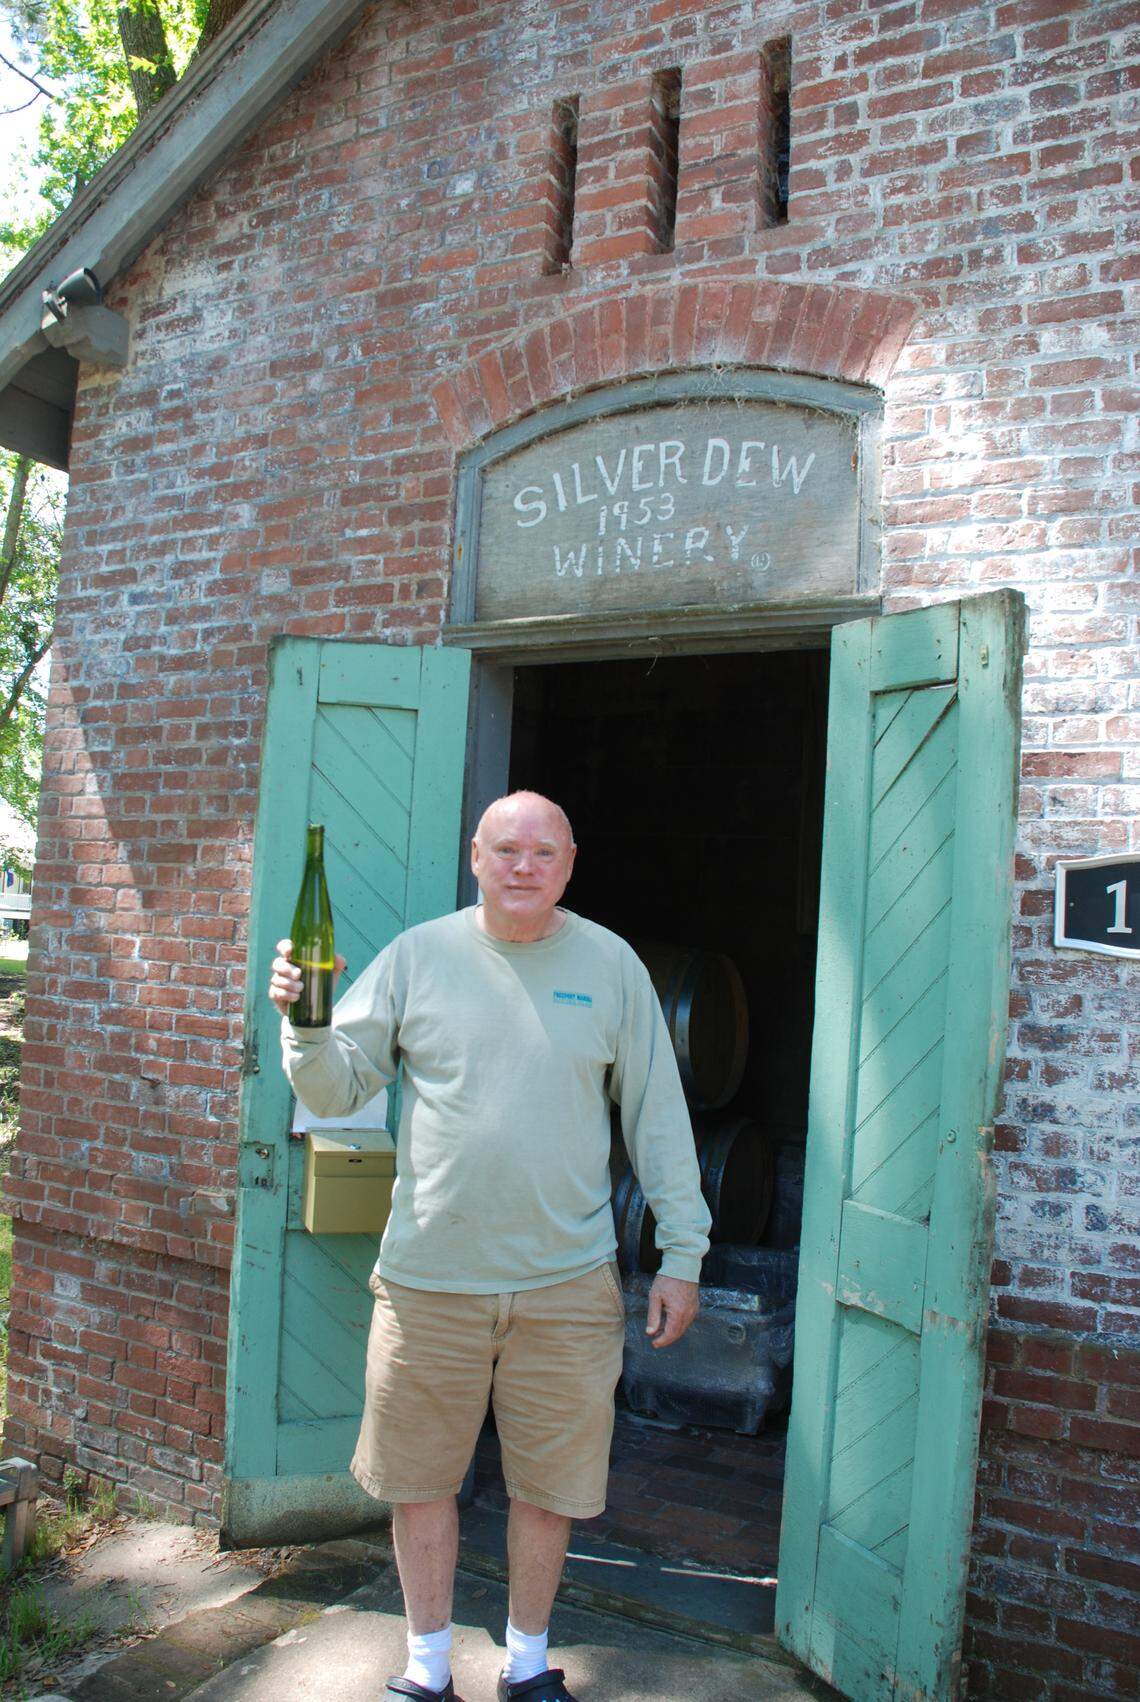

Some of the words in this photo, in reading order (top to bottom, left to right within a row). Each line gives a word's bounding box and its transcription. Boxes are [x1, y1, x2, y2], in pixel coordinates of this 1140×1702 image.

[513, 440, 688, 528] SILVER
[702, 438, 816, 494] DEW
[598, 492, 676, 536] 1953
[553, 524, 750, 577] WINERY
[1106, 879, 1132, 933] 1
